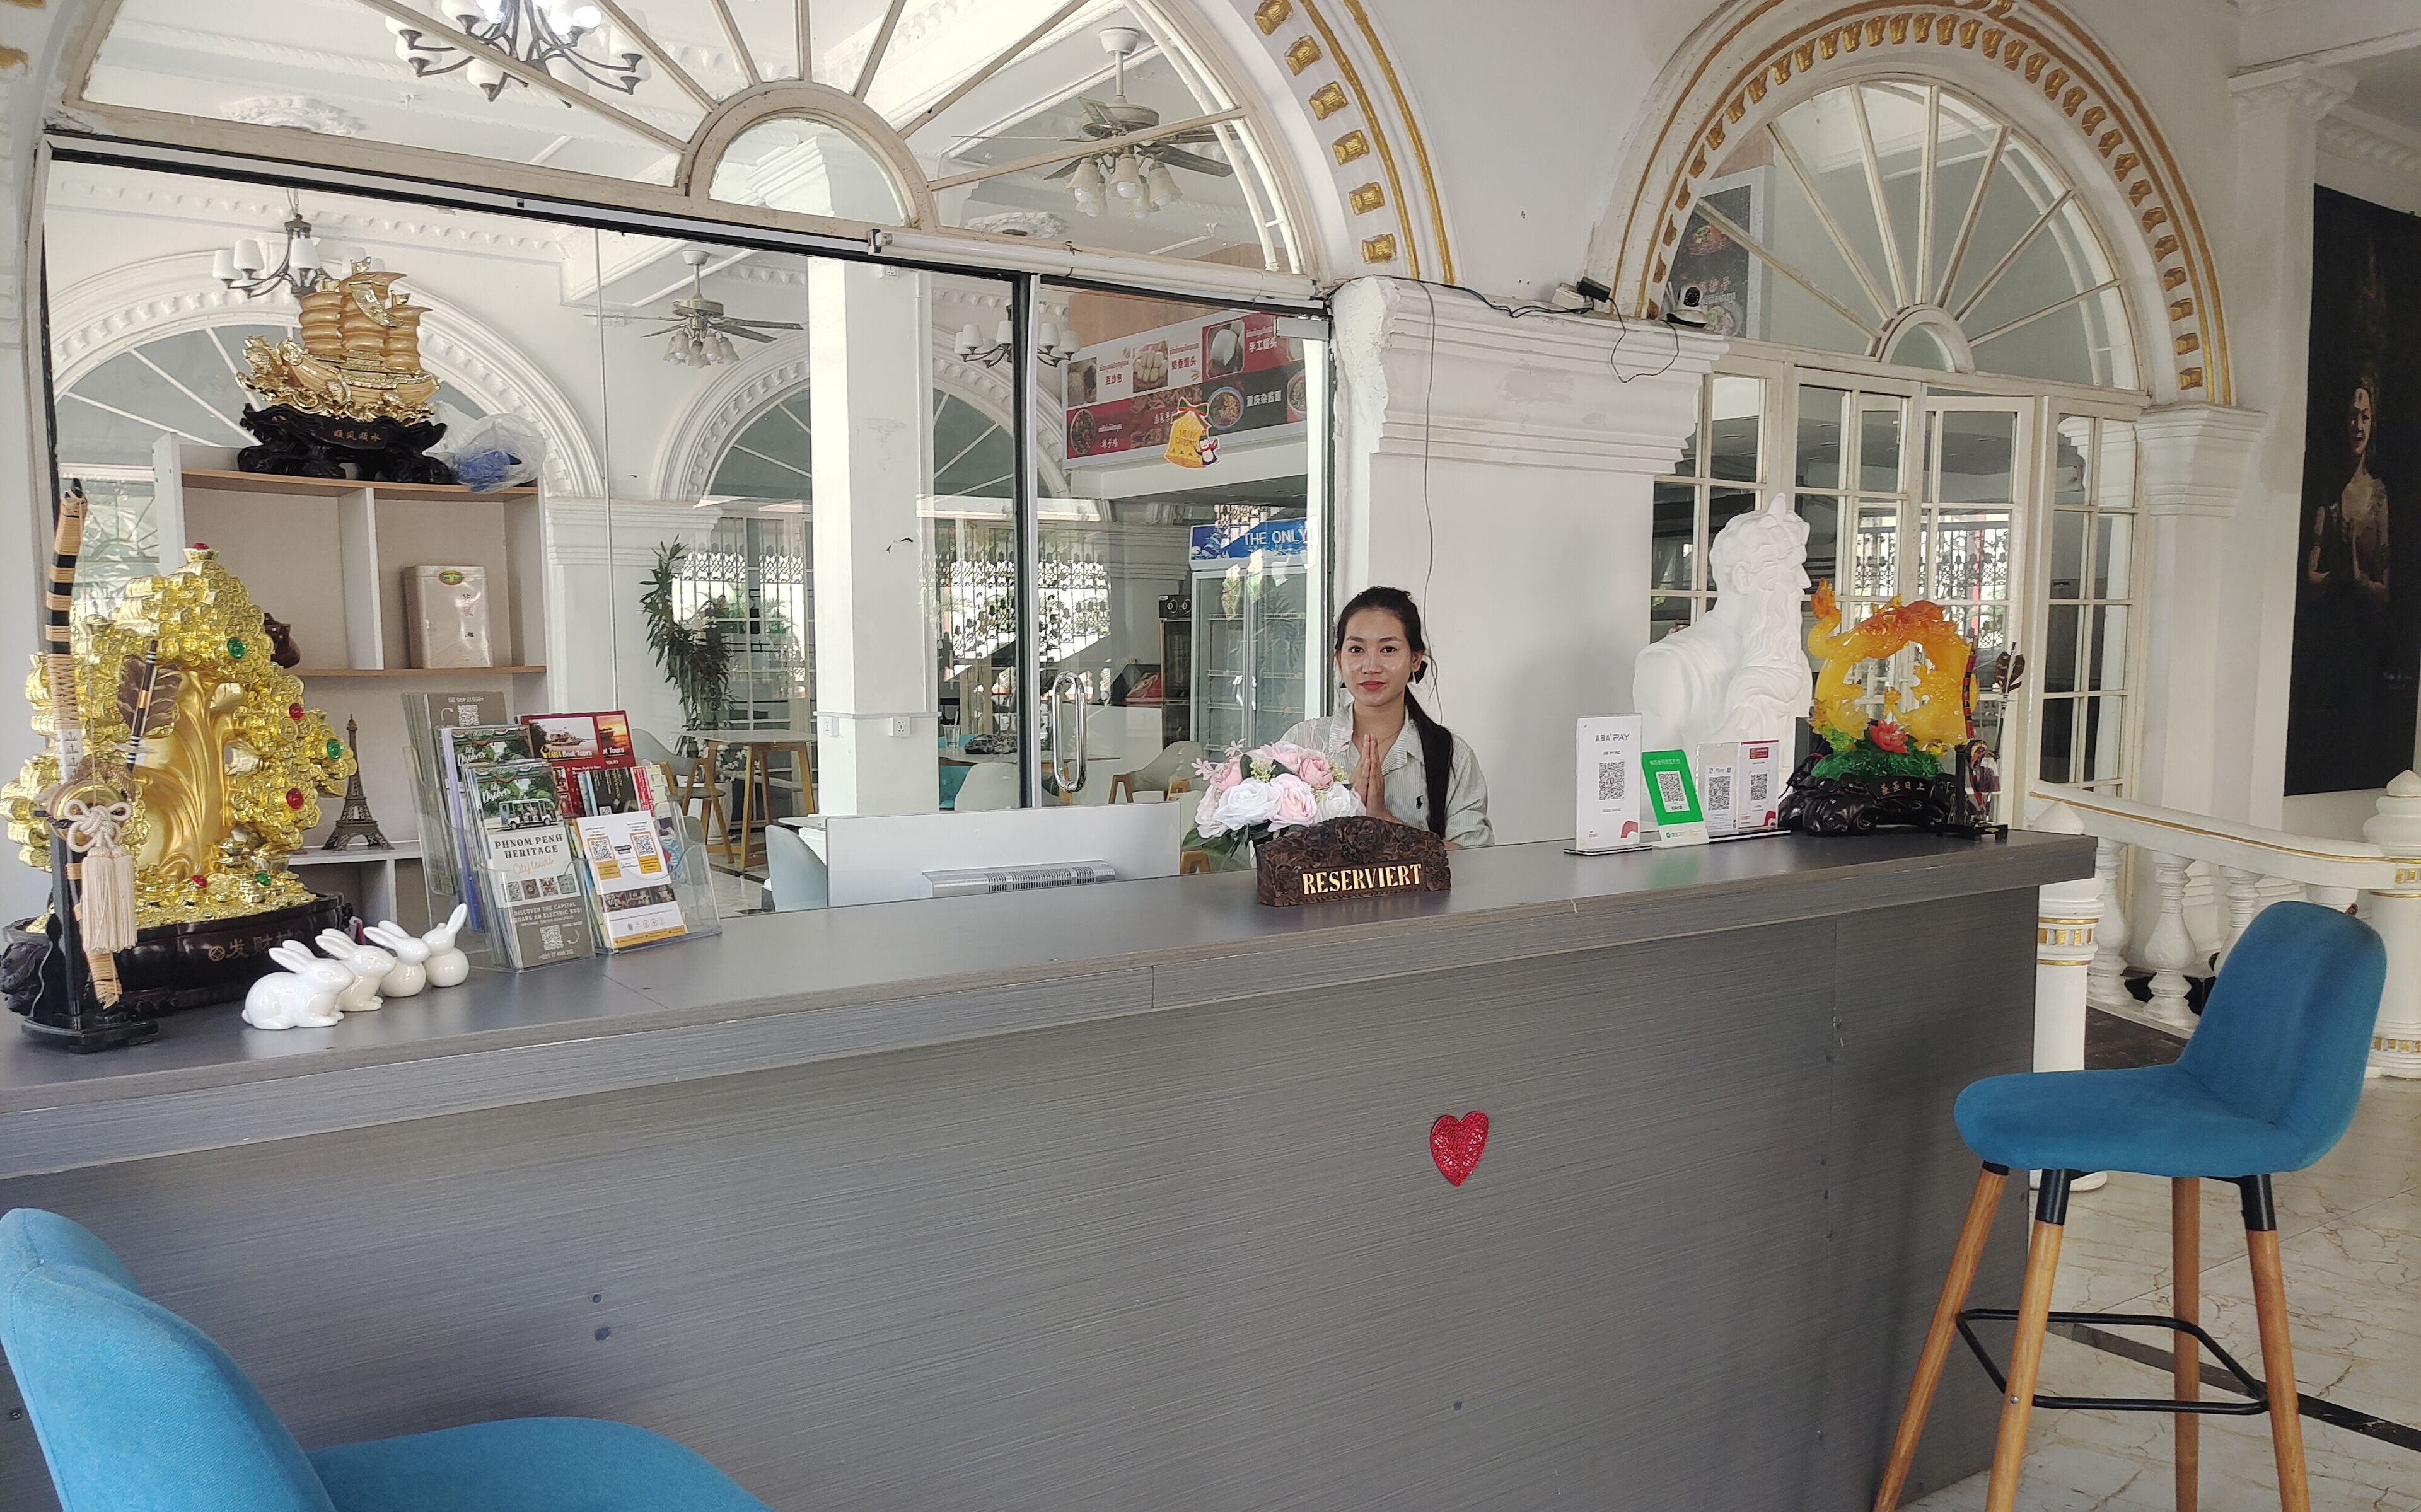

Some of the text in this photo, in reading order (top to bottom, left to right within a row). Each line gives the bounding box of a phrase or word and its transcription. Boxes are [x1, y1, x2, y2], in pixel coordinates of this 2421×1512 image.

[1244, 529, 1307, 546] THE ONLY
[1613, 732, 1630, 741] PAY
[494, 834, 563, 850] PHNOM PENH
[504, 845, 559, 859] HERITAGE
[1302, 863, 1422, 895] RESERVIERT
[513, 907, 541, 916] DISCOVER
[543, 909, 569, 918] ELECTRIC
